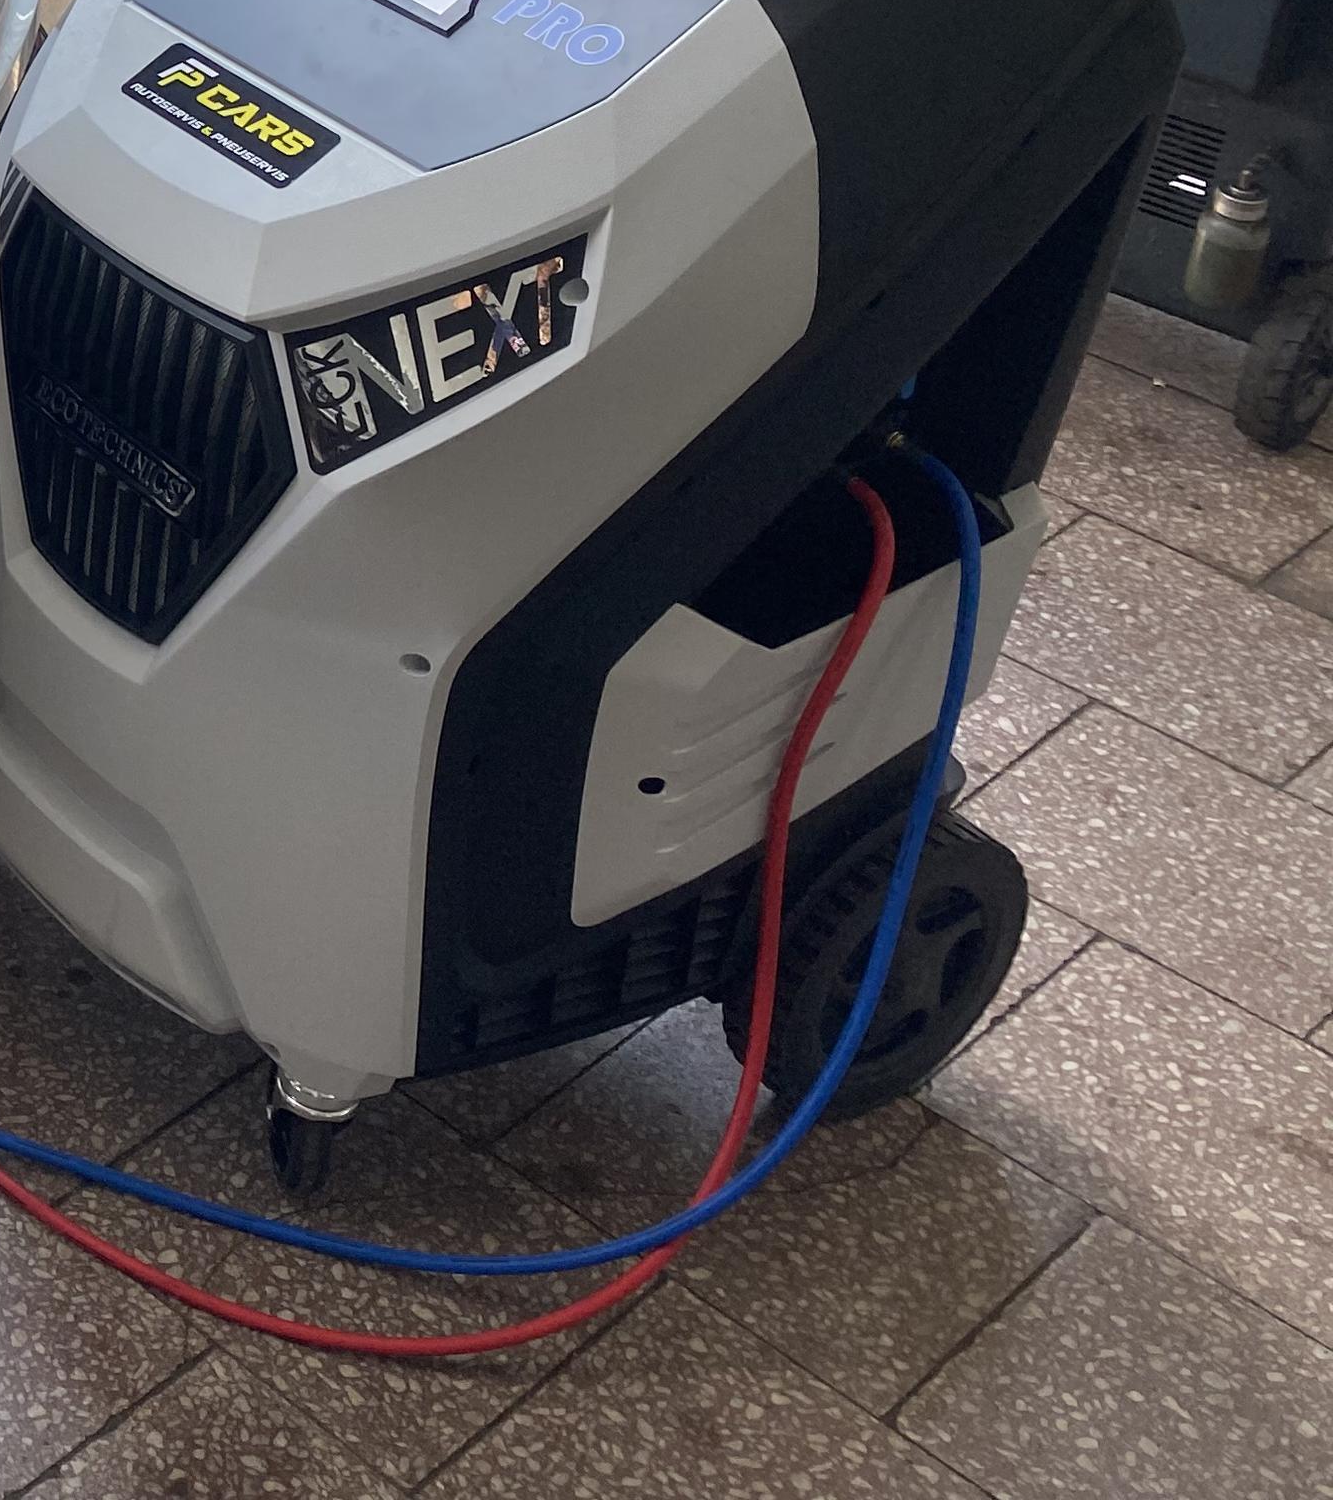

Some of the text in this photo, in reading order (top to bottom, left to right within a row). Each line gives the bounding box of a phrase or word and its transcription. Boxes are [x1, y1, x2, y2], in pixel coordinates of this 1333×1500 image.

[130, 82, 290, 182] AUTOSERVIS & PNEUSERVIS
[196, 83, 315, 156] CARS
[294, 256, 564, 441] NEXT
